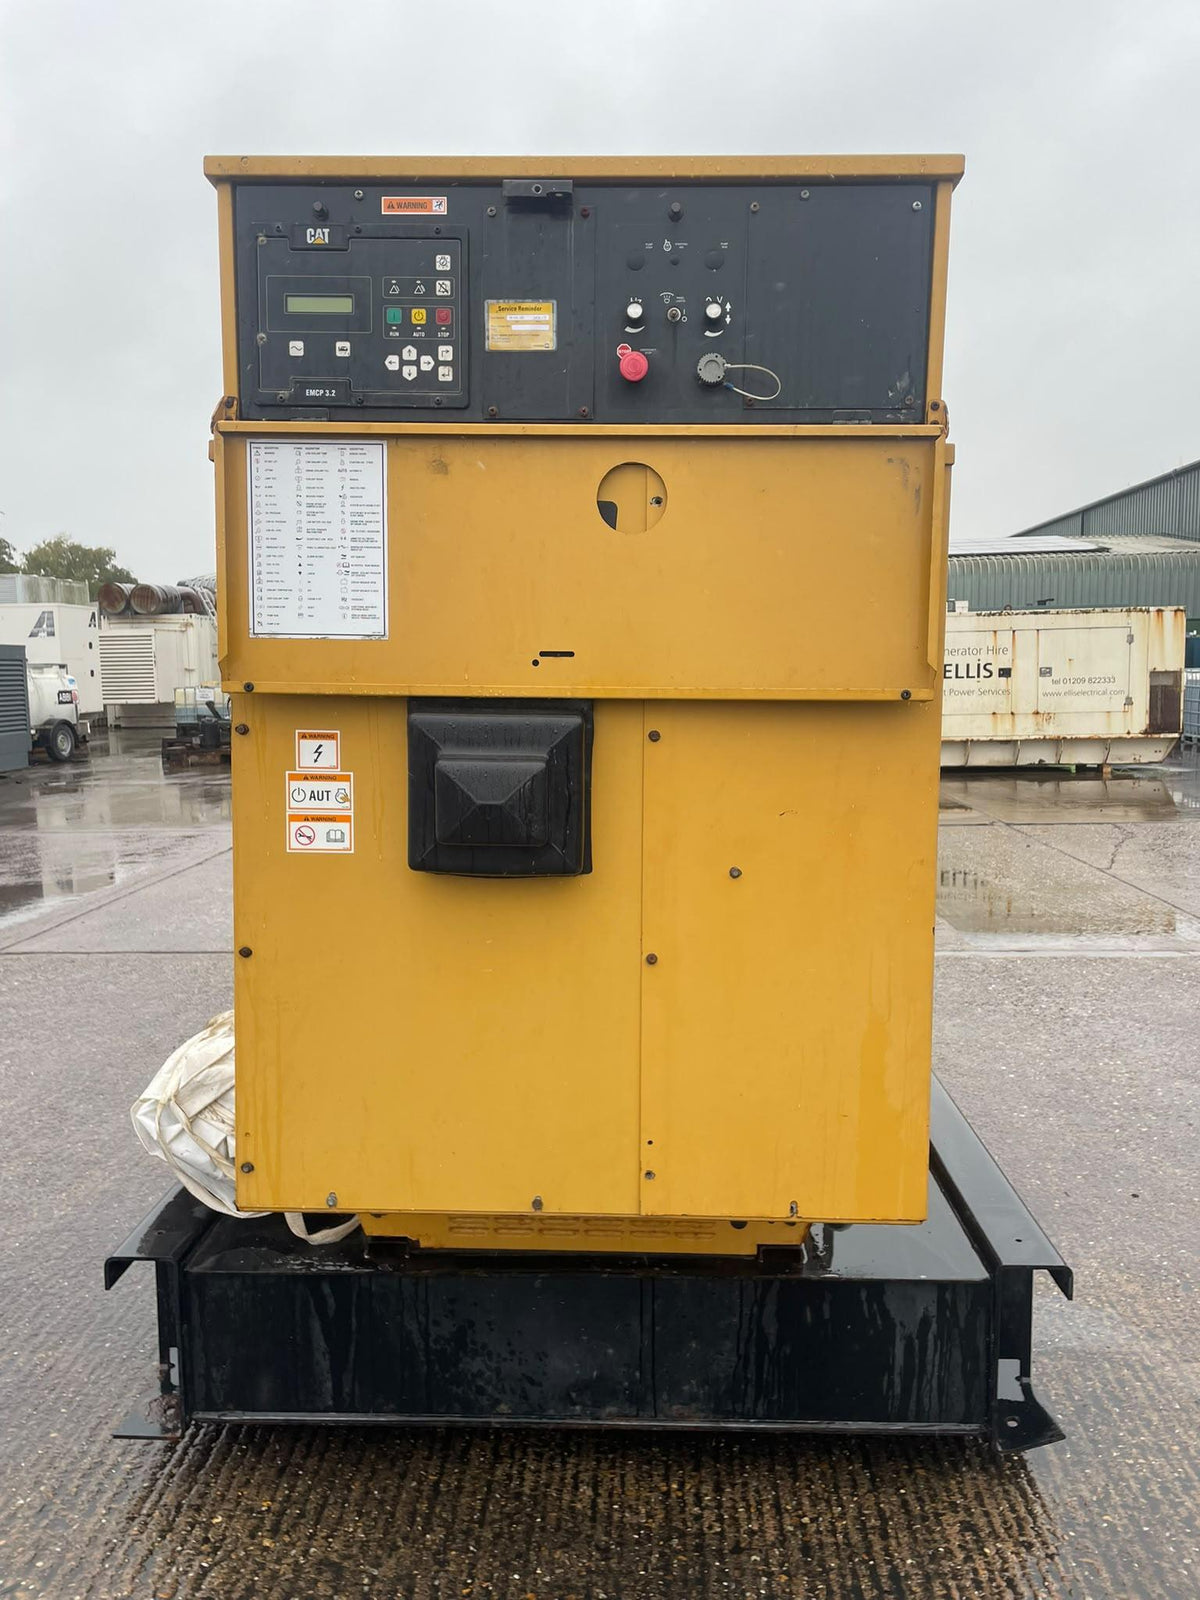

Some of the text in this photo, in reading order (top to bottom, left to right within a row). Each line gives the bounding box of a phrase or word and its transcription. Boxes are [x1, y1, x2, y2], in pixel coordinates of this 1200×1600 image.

[396, 201, 428, 210] WARNING
[306, 228, 330, 244] CAT
[305, 389, 336, 397] EMCP 3.2
[986, 645, 1009, 656] Hire
[1051, 676, 1116, 685] tel 01209 822333
[949, 688, 975, 696] Power
[977, 687, 1011, 696] Services
[1042, 688, 1126, 698] www.elliselectrical.com
